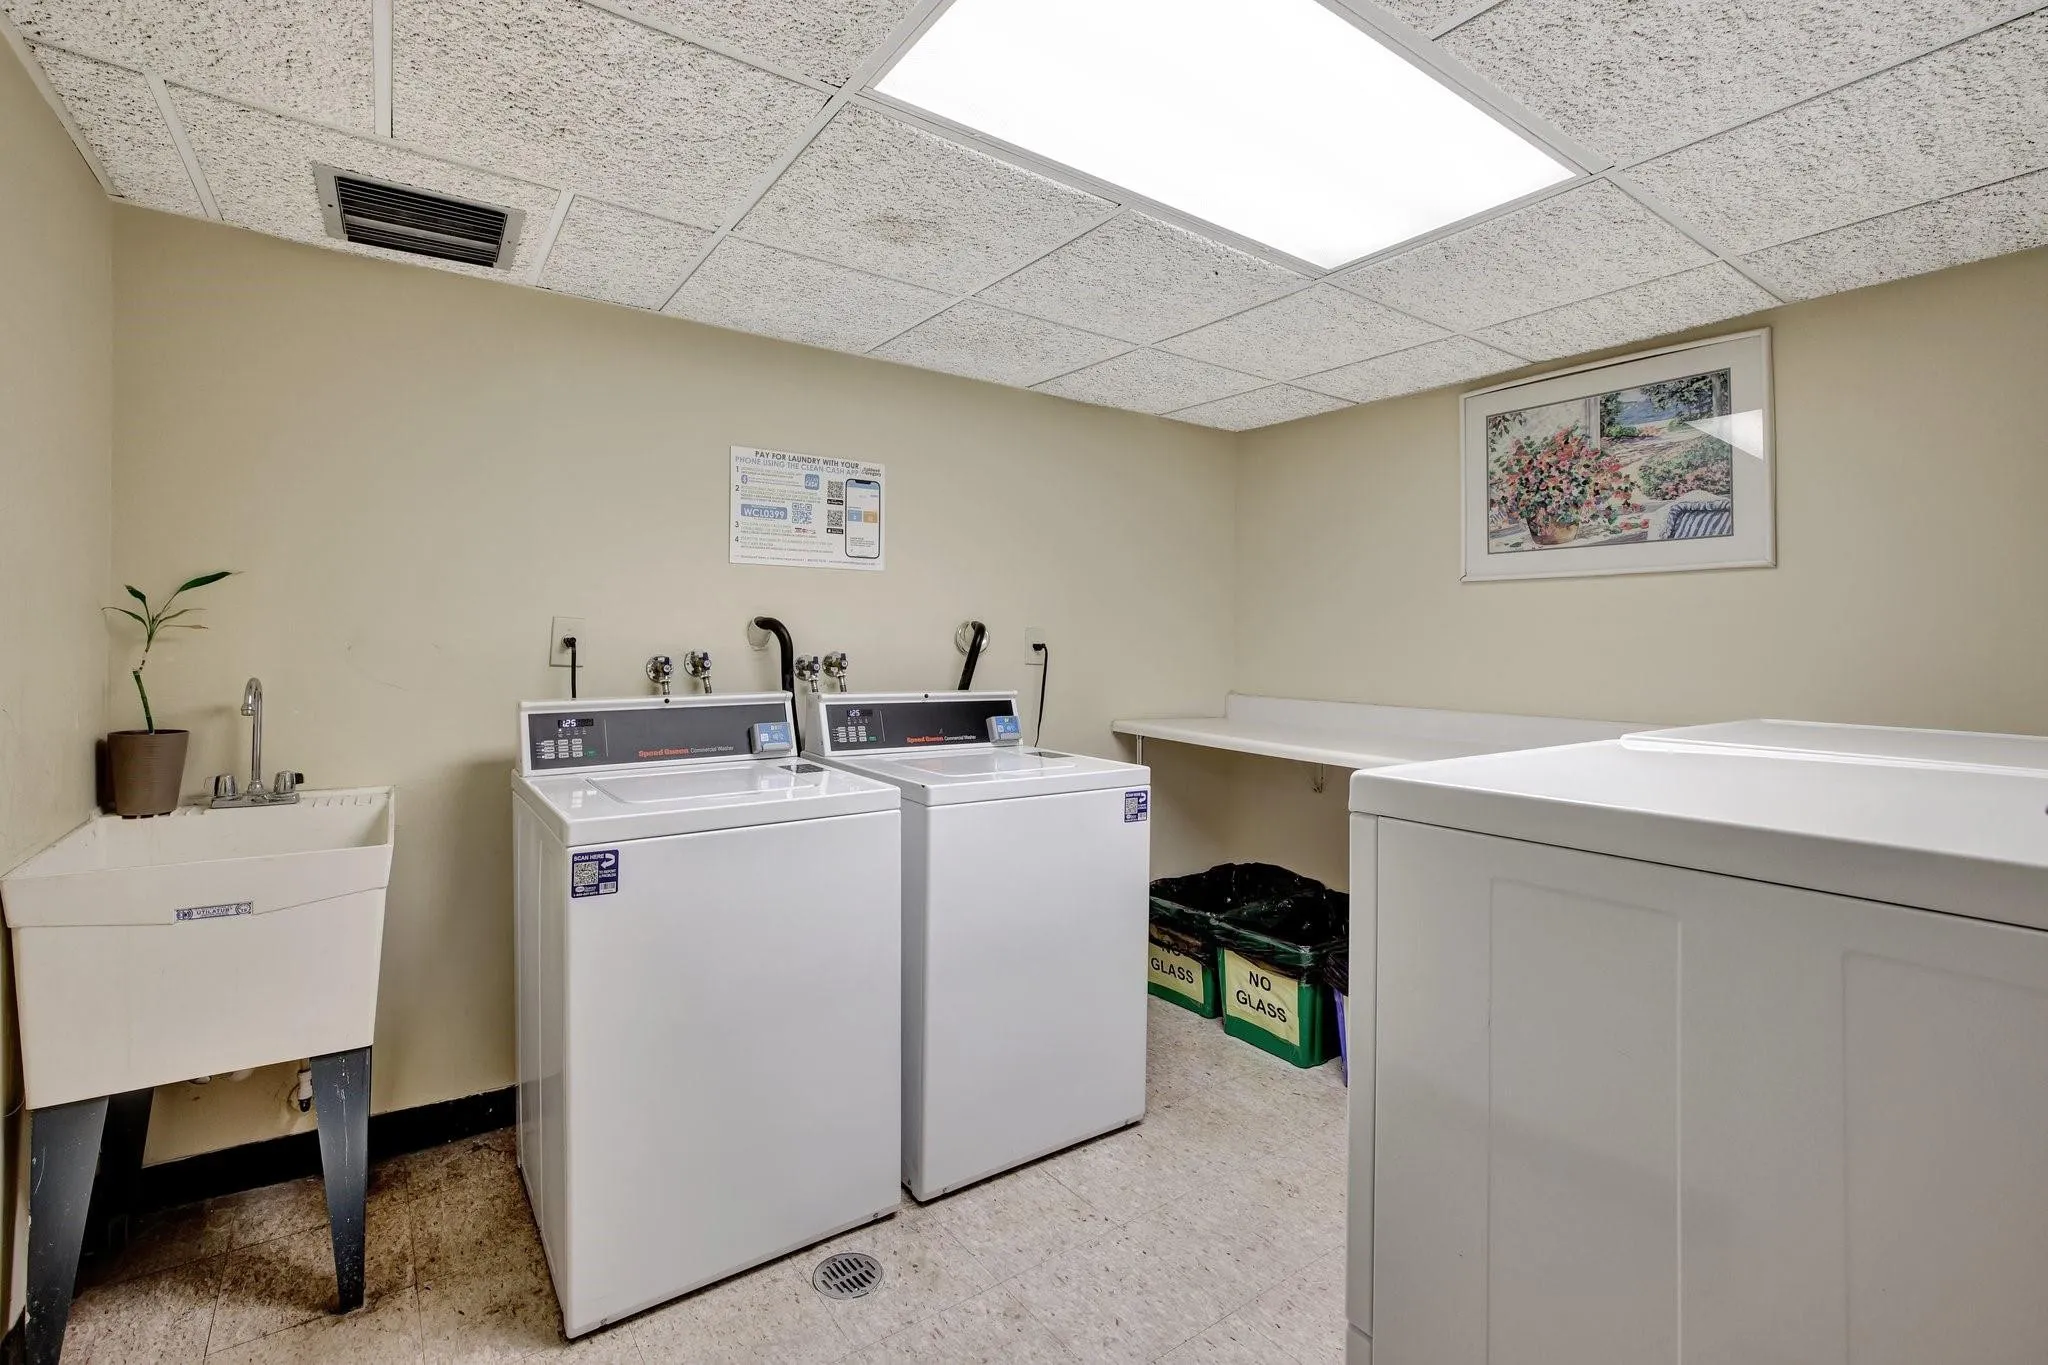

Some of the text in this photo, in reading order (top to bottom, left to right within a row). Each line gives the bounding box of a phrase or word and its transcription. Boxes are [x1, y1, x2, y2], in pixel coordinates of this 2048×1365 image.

[735, 456, 761, 465] PHONE
[763, 459, 785, 468] USING
[787, 461, 800, 470] THE
[801, 463, 824, 473] CLEAN
[826, 466, 845, 475] CASH
[755, 451, 860, 469] PAY FOR LAUNDRY WITH YOUR
[906, 736, 925, 744] Speed
[638, 749, 664, 758] Speed
[664, 747, 689, 756] Queen
[1151, 957, 1194, 984] GLASS
[1249, 970, 1272, 992] NO
[1236, 989, 1287, 1023] GLASS
